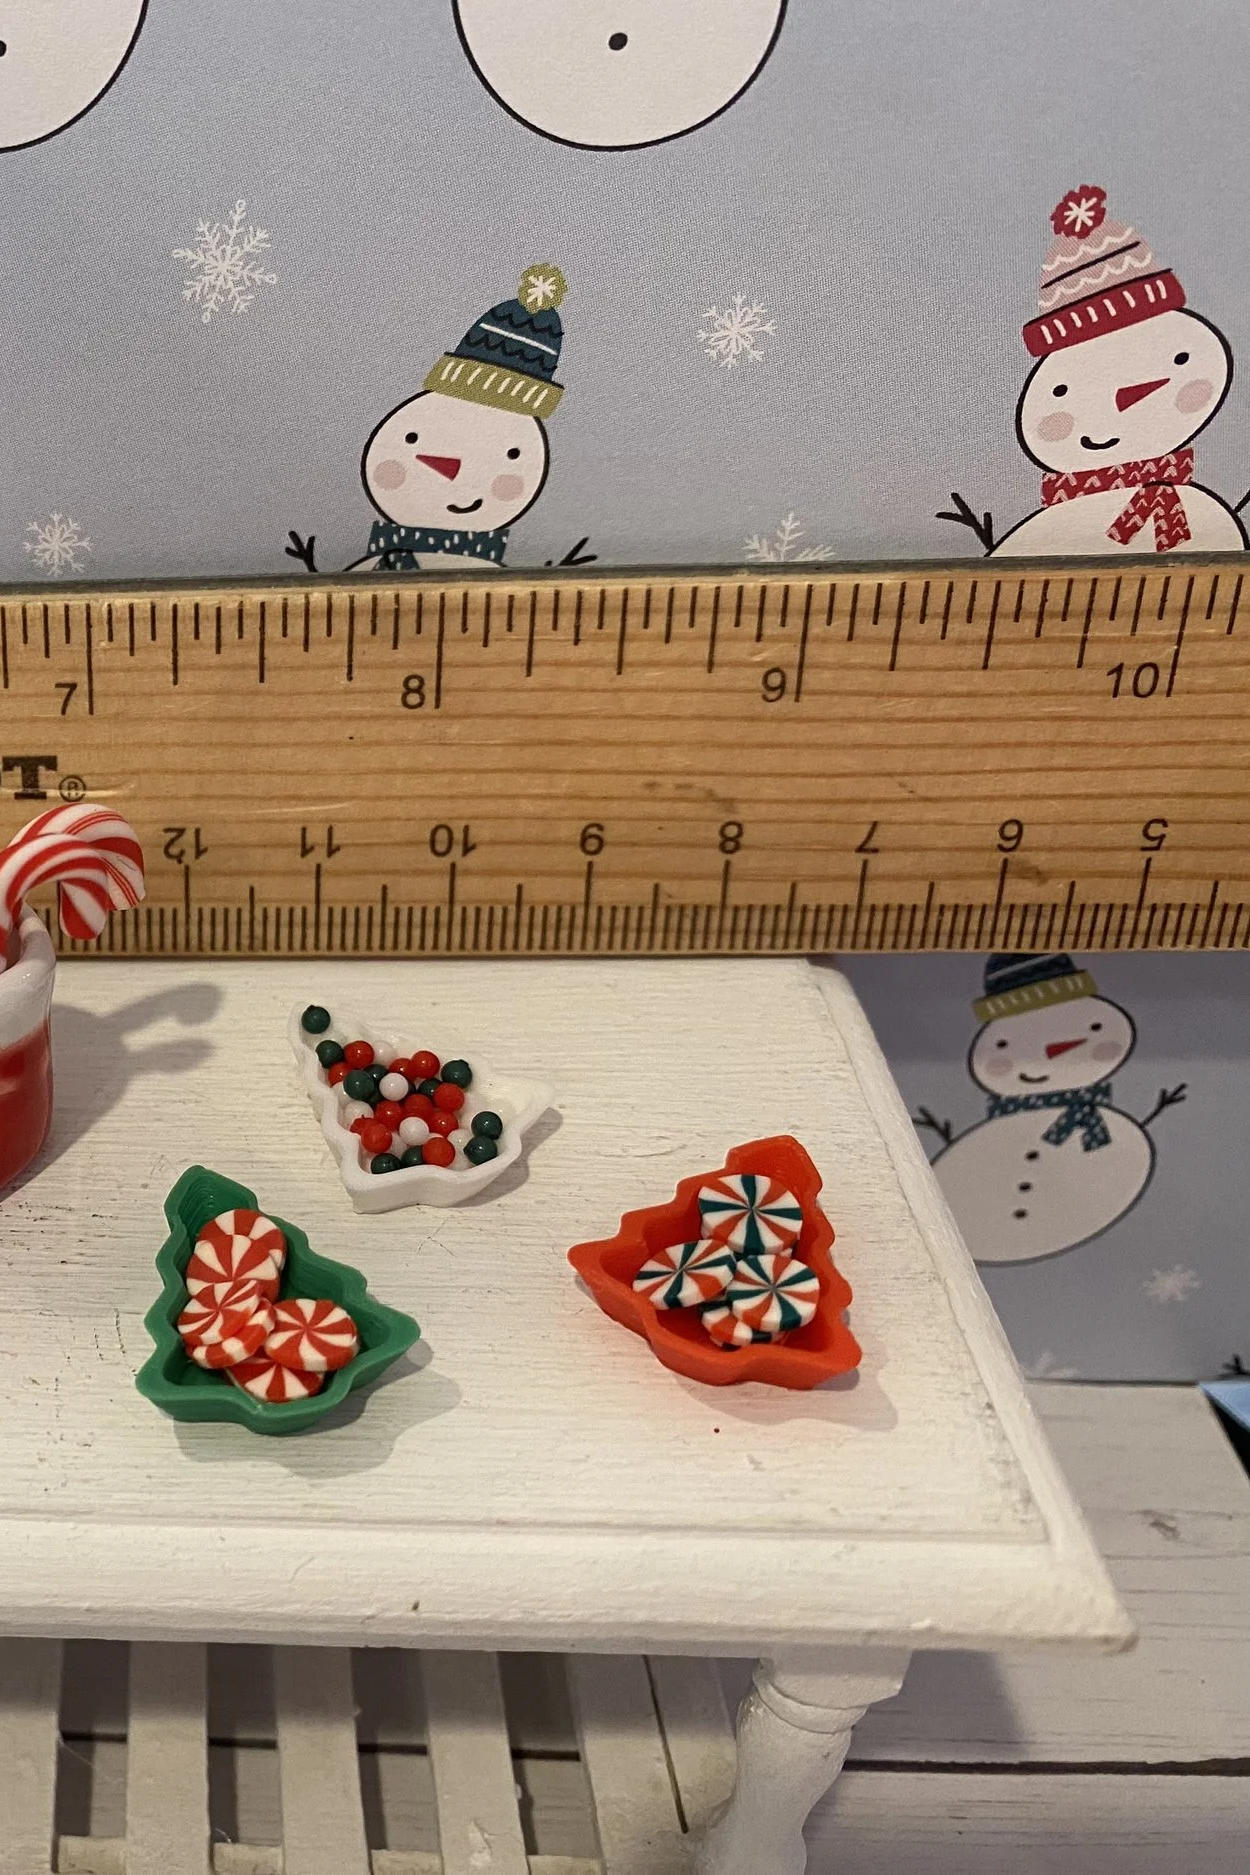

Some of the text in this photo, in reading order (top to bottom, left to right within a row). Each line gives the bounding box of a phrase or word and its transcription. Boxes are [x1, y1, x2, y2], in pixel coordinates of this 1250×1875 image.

[54, 682, 78, 716] 7
[400, 674, 426, 710] 8
[761, 666, 787, 703] 9
[1106, 661, 1160, 699] 10
[163, 827, 209, 861] 12
[300, 825, 342, 859] 11
[428, 823, 477, 858] 10
[579, 822, 607, 856] 9
[718, 820, 744, 855] 8
[854, 820, 881, 854] 7
[996, 818, 1024, 854] 6
[1139, 818, 1169, 852] 5
